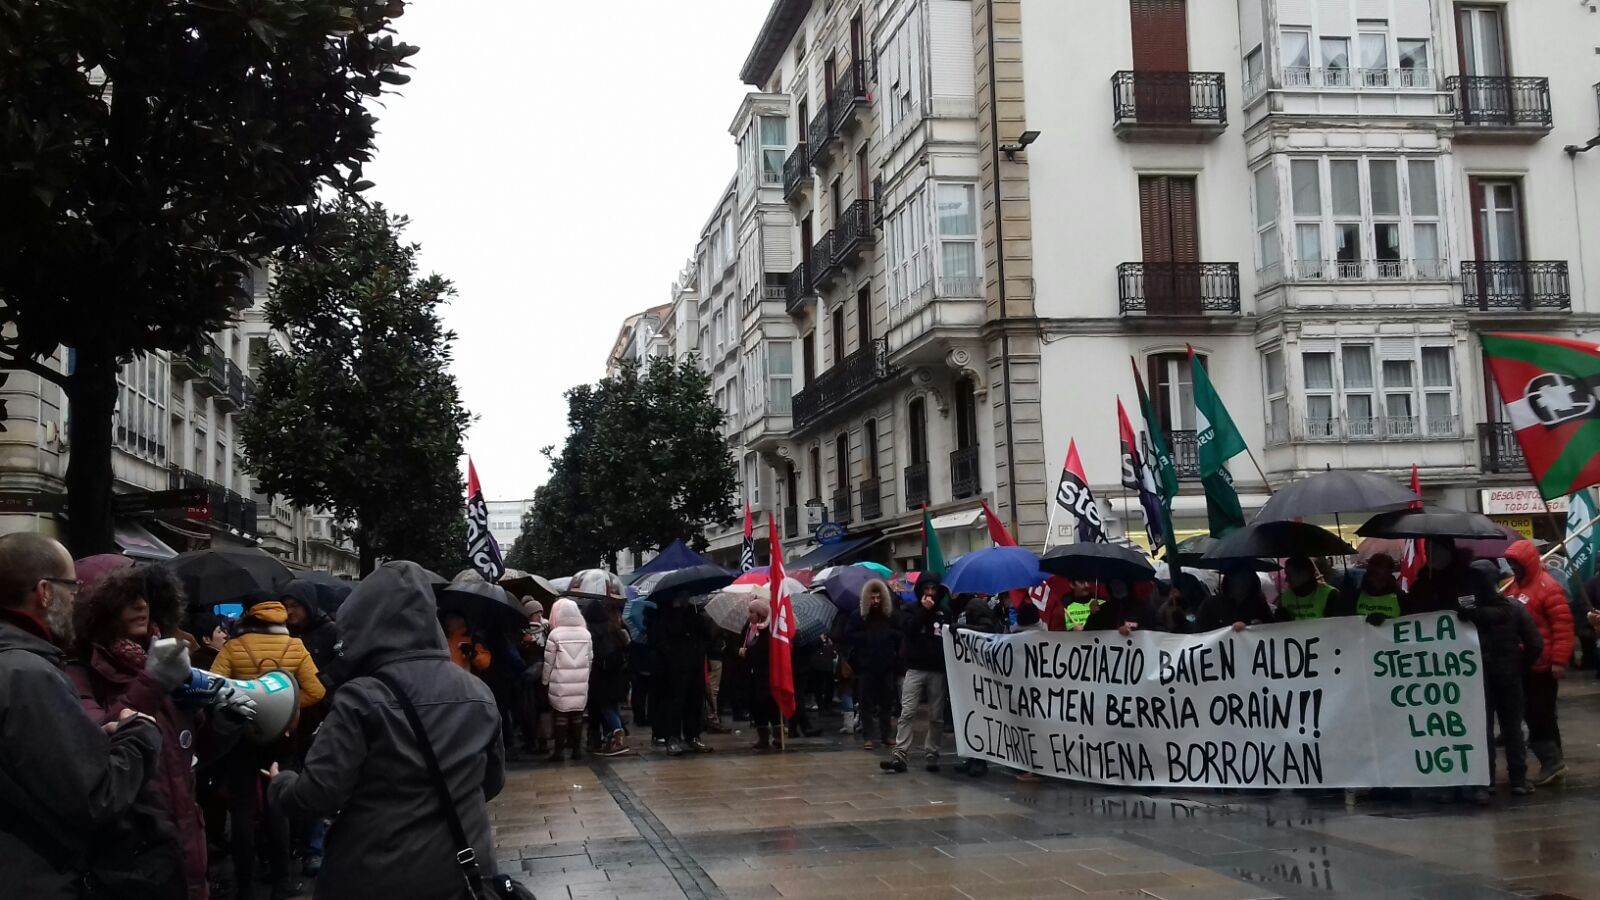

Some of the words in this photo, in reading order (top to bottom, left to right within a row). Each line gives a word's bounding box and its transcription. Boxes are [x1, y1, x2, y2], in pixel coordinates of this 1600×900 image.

[1505, 503, 1529, 511] TODO
[1393, 614, 1457, 644] ELA
[1024, 637, 1145, 686] NEGOZIAZIO
[1159, 637, 1235, 686] BATEN
[1373, 649, 1478, 678] STEILAS
[973, 673, 1094, 727] HITZARMEN
[1106, 687, 1200, 730] BERRIA
[1209, 686, 1324, 739] ORAIN!!
[1390, 681, 1462, 708] CCOO
[1408, 710, 1467, 738] LAB
[964, 709, 1044, 771] GIZARTE
[1049, 733, 1155, 782] EKIMENA
[1166, 741, 1324, 786] BORROKAN
[1415, 743, 1475, 775] UGT
